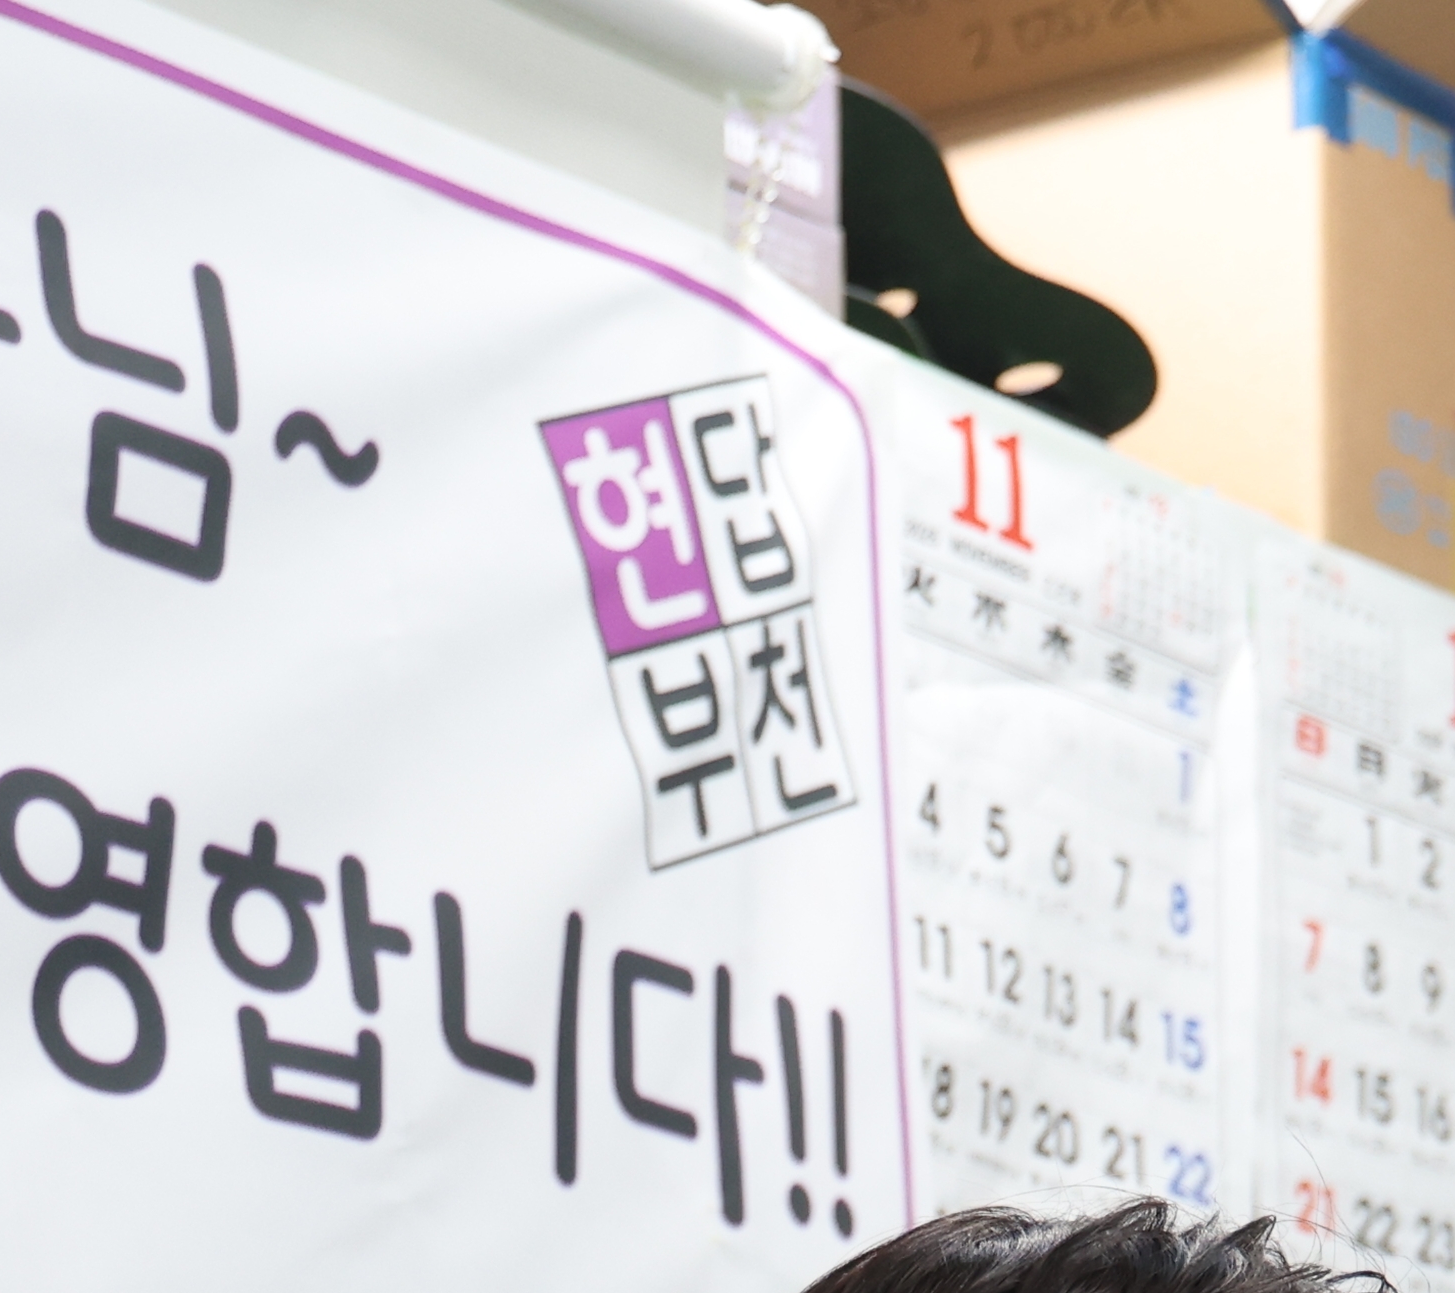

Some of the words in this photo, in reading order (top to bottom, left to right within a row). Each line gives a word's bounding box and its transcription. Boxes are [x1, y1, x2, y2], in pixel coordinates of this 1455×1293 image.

[948, 414, 1034, 553] 11
[920, 782, 940, 832] 4
[985, 805, 1012, 860] 5
[1052, 833, 1074, 885] 6
[1113, 857, 1131, 908] 7
[1169, 881, 1192, 936] 8
[1366, 815, 1381, 867] 1
[1420, 837, 1442, 891] 2
[915, 915, 954, 979] 11
[982, 940, 1023, 1003] 12
[1043, 964, 1078, 1028] 13
[1101, 987, 1139, 1049] 14
[1161, 1011, 1206, 1071] 15
[1302, 918, 1324, 972] 7
[1364, 943, 1386, 996] 8
[1421, 963, 1443, 1015] 9
[980, 1079, 1016, 1141] 19
[1033, 1102, 1080, 1165] 20
[1103, 1125, 1146, 1184] 21
[1164, 1144, 1213, 1205] 22
[1292, 1047, 1332, 1108] 14
[1355, 1067, 1396, 1125] 15
[1416, 1085, 1453, 1144] 16
[1295, 1179, 1337, 1240] 21
[1351, 1197, 1399, 1256] 22
